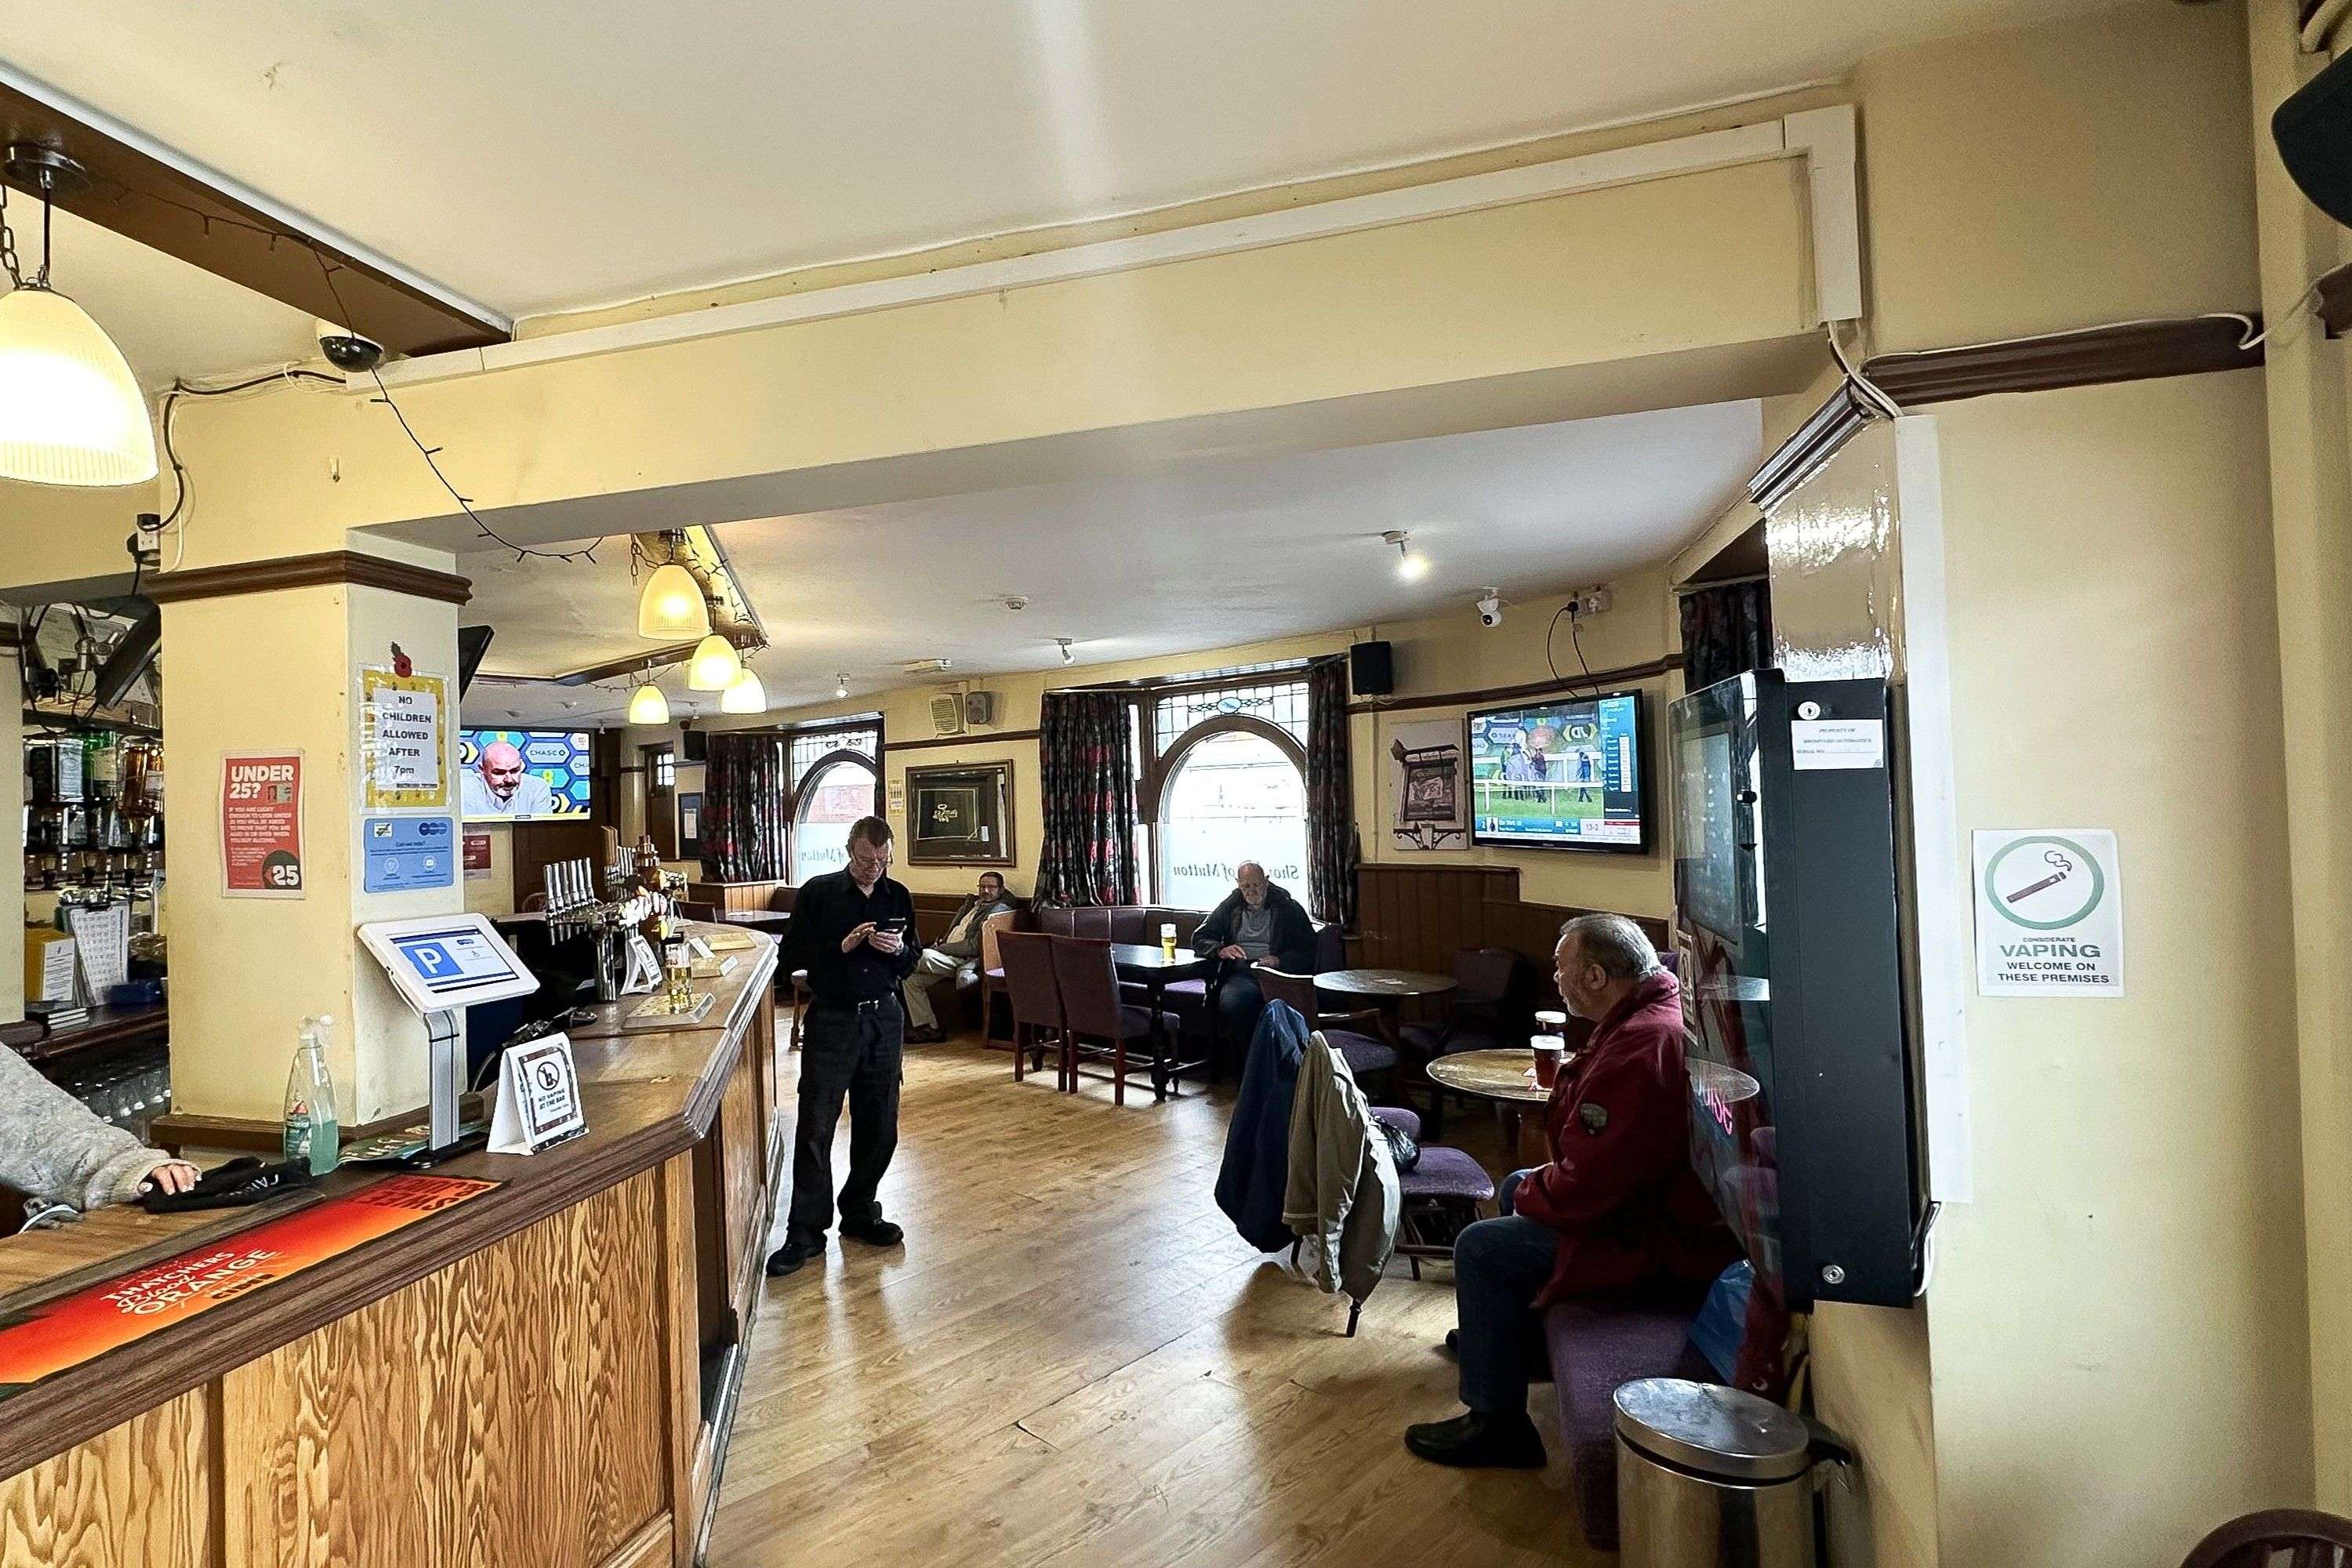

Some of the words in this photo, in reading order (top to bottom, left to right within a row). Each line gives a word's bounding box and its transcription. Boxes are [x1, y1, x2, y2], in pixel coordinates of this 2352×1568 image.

[398, 695, 413, 705] NO
[382, 712, 432, 724] CHILDREN
[382, 729, 429, 740] ALLOWED
[388, 748, 420, 757] AFTER
[230, 764, 294, 782] UNDER
[394, 766, 415, 775] 7pm
[229, 782, 261, 799] 25?
[273, 865, 299, 886] 25
[1999, 944, 2101, 958] VAPING
[2007, 962, 2072, 971] WELCOME
[2077, 962, 2096, 971] ON
[2042, 974, 2110, 983] PREMISES
[100, 1251, 235, 1301] THATCHERS
[134, 1248, 278, 1316] ORANGE
[116, 1274, 196, 1314] Blood
